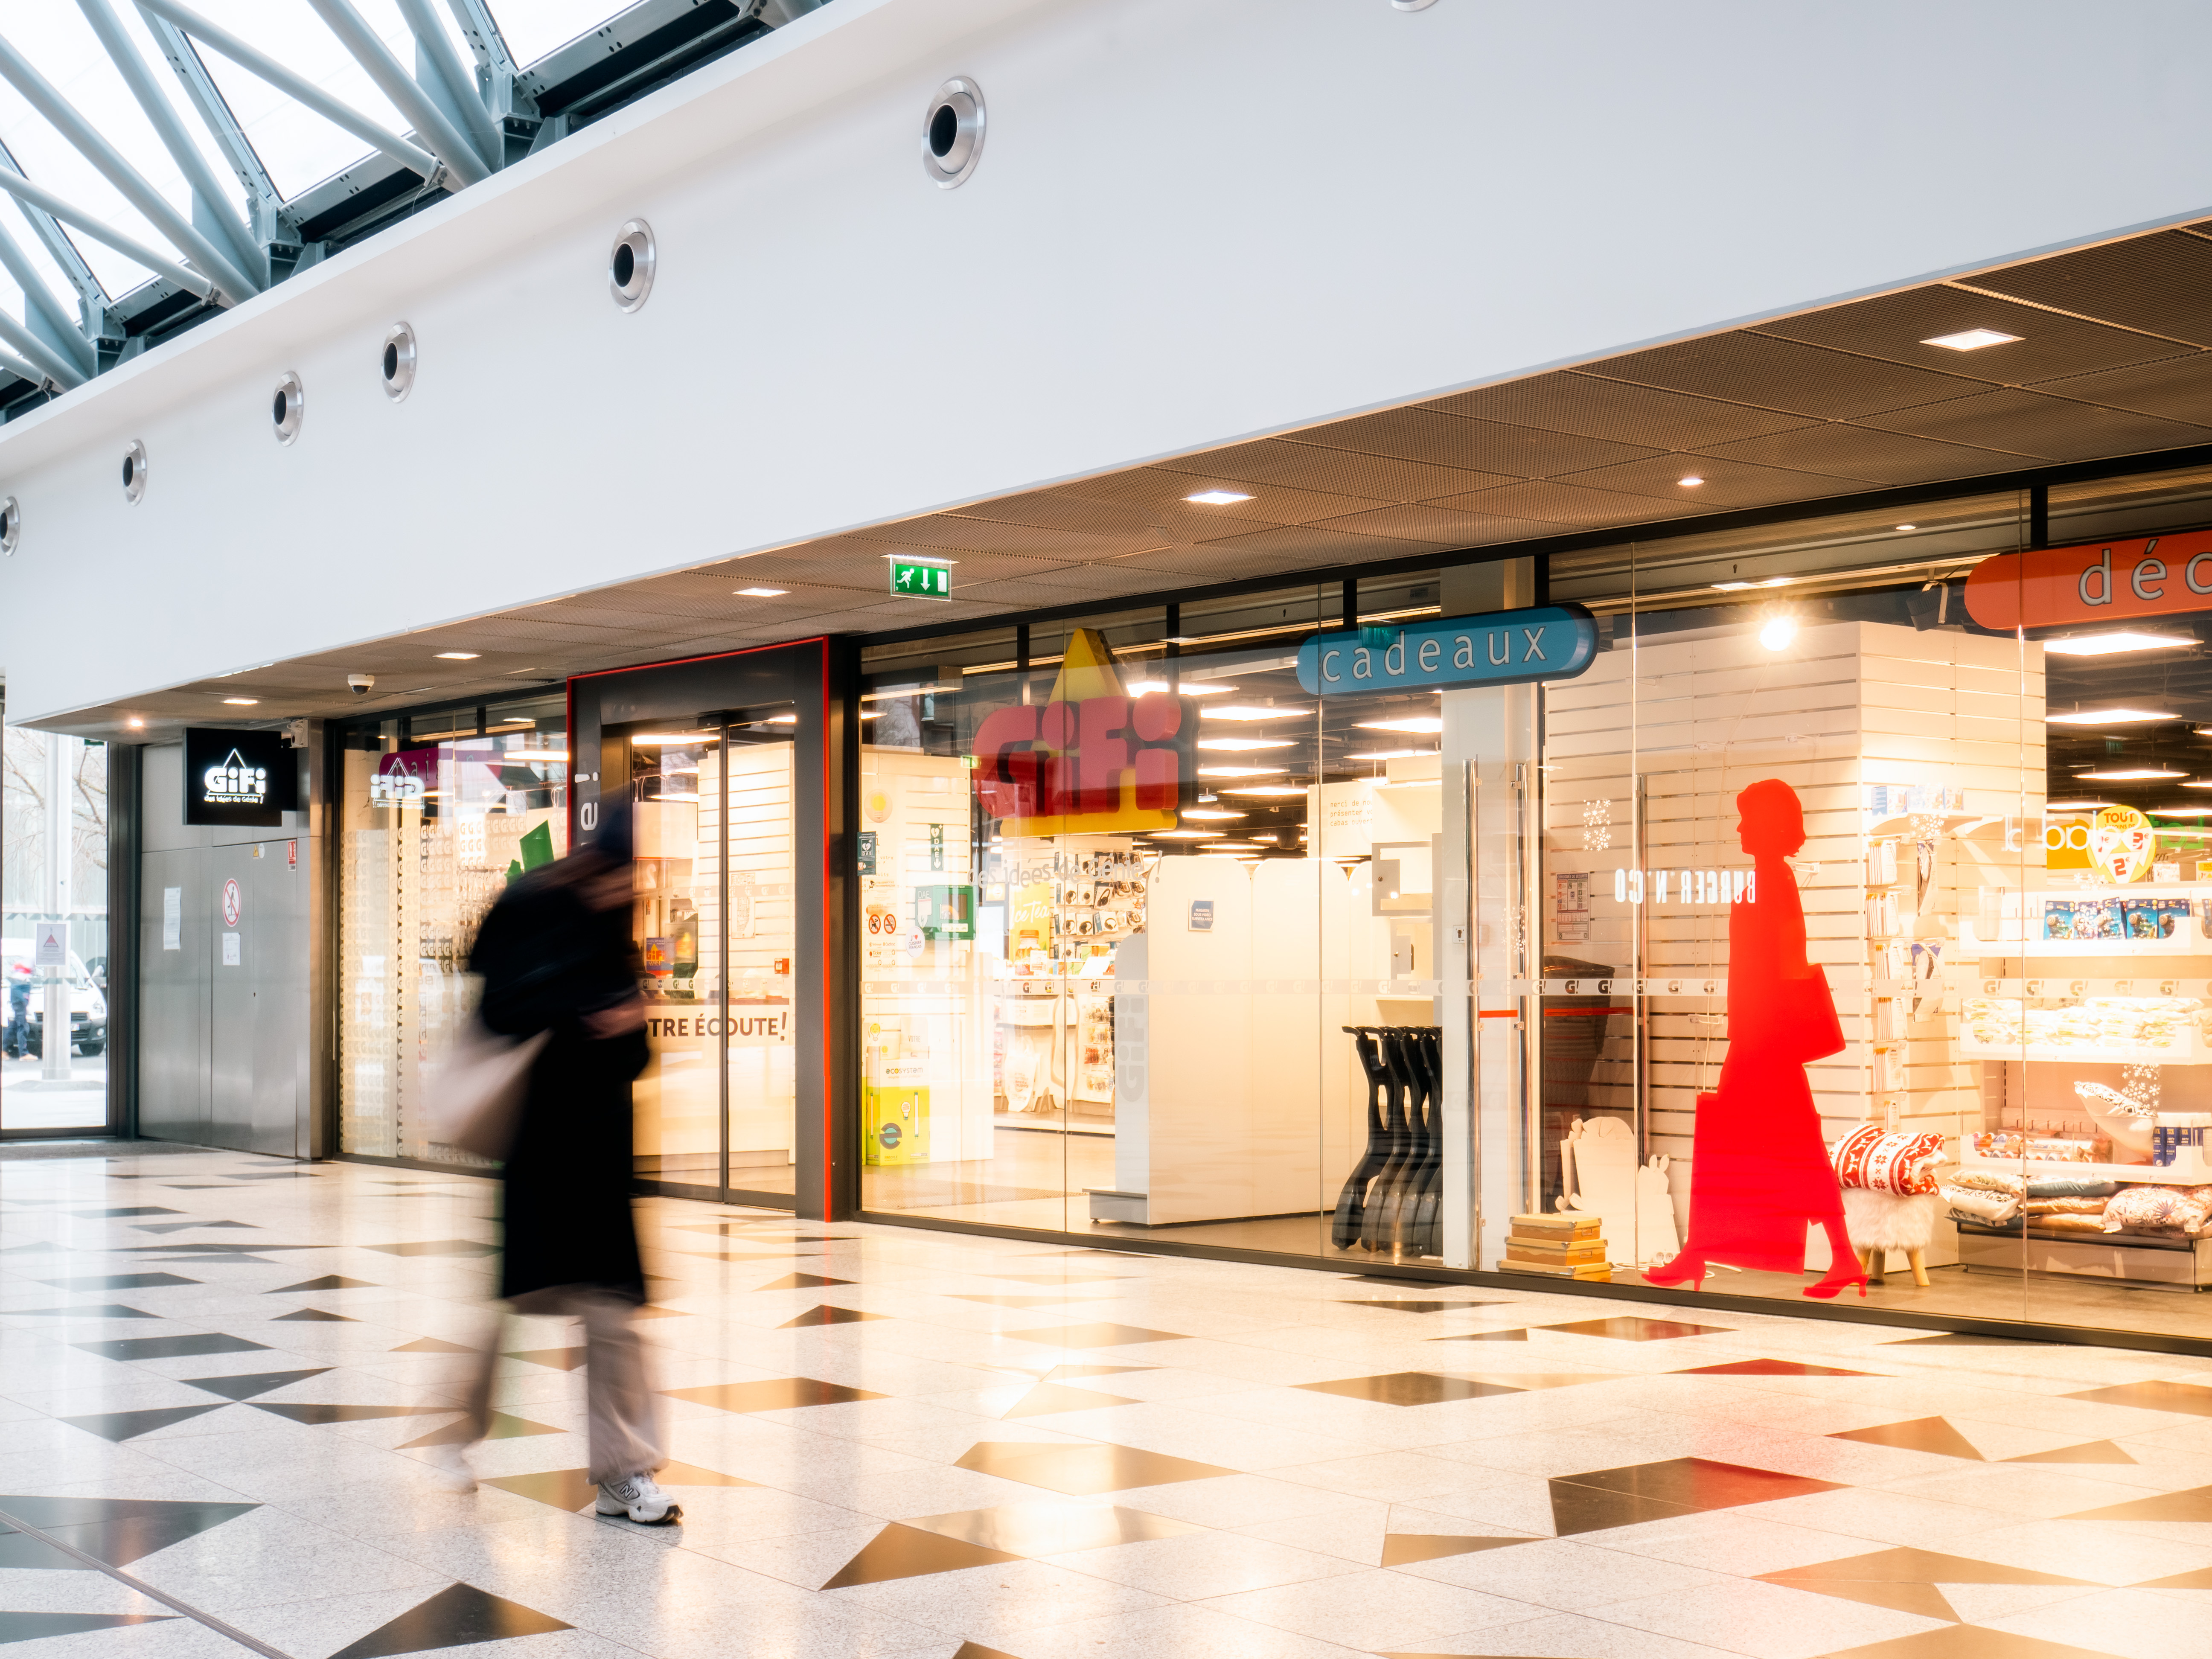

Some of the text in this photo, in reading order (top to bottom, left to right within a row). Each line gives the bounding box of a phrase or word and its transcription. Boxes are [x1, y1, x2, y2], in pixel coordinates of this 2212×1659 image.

[1321, 626, 1548, 683] cadeaux
[205, 766, 266, 794] GiFi
[1330, 810, 1362, 818] présenter
[2104, 812, 2134, 823] TOUT
[1004, 859, 1051, 888] idées
[1058, 856, 1080, 884] de
[1089, 850, 1144, 881] Génie
[918, 891, 929, 899] DAE
[1023, 900, 1049, 923] Tea
[1532, 980, 1719, 995] G! G! G! G! G! G!
[1118, 997, 1144, 1102] GiFi
